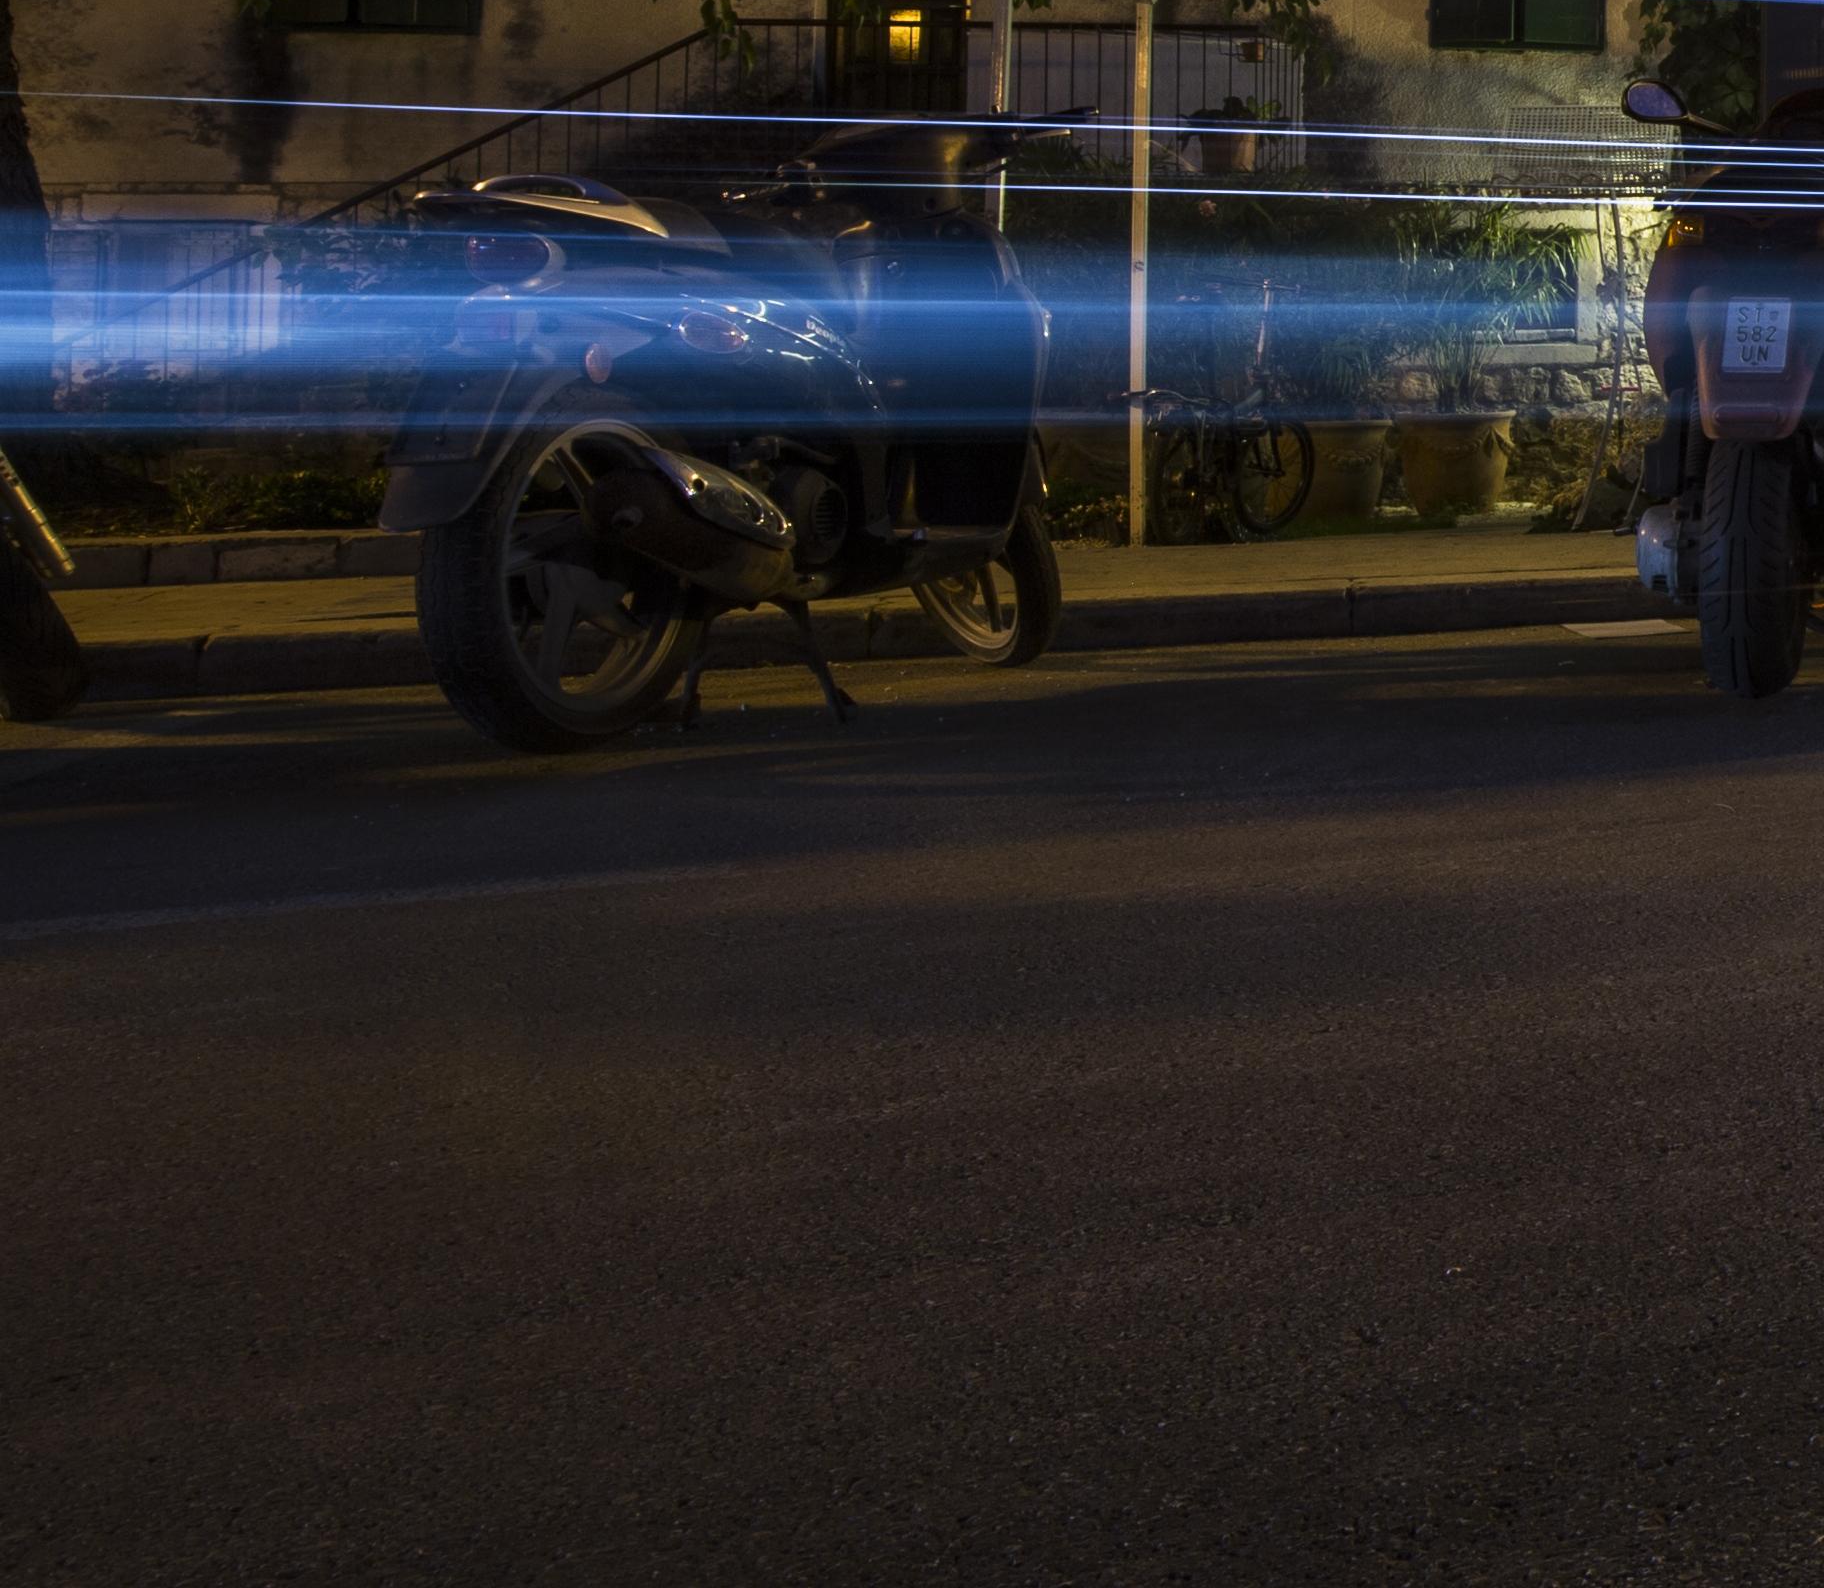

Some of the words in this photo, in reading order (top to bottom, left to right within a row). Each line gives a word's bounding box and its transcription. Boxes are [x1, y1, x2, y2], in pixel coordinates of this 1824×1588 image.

[1738, 306, 1764, 324] ST
[1737, 325, 1777, 343] 582
[1741, 345, 1769, 363] UN
